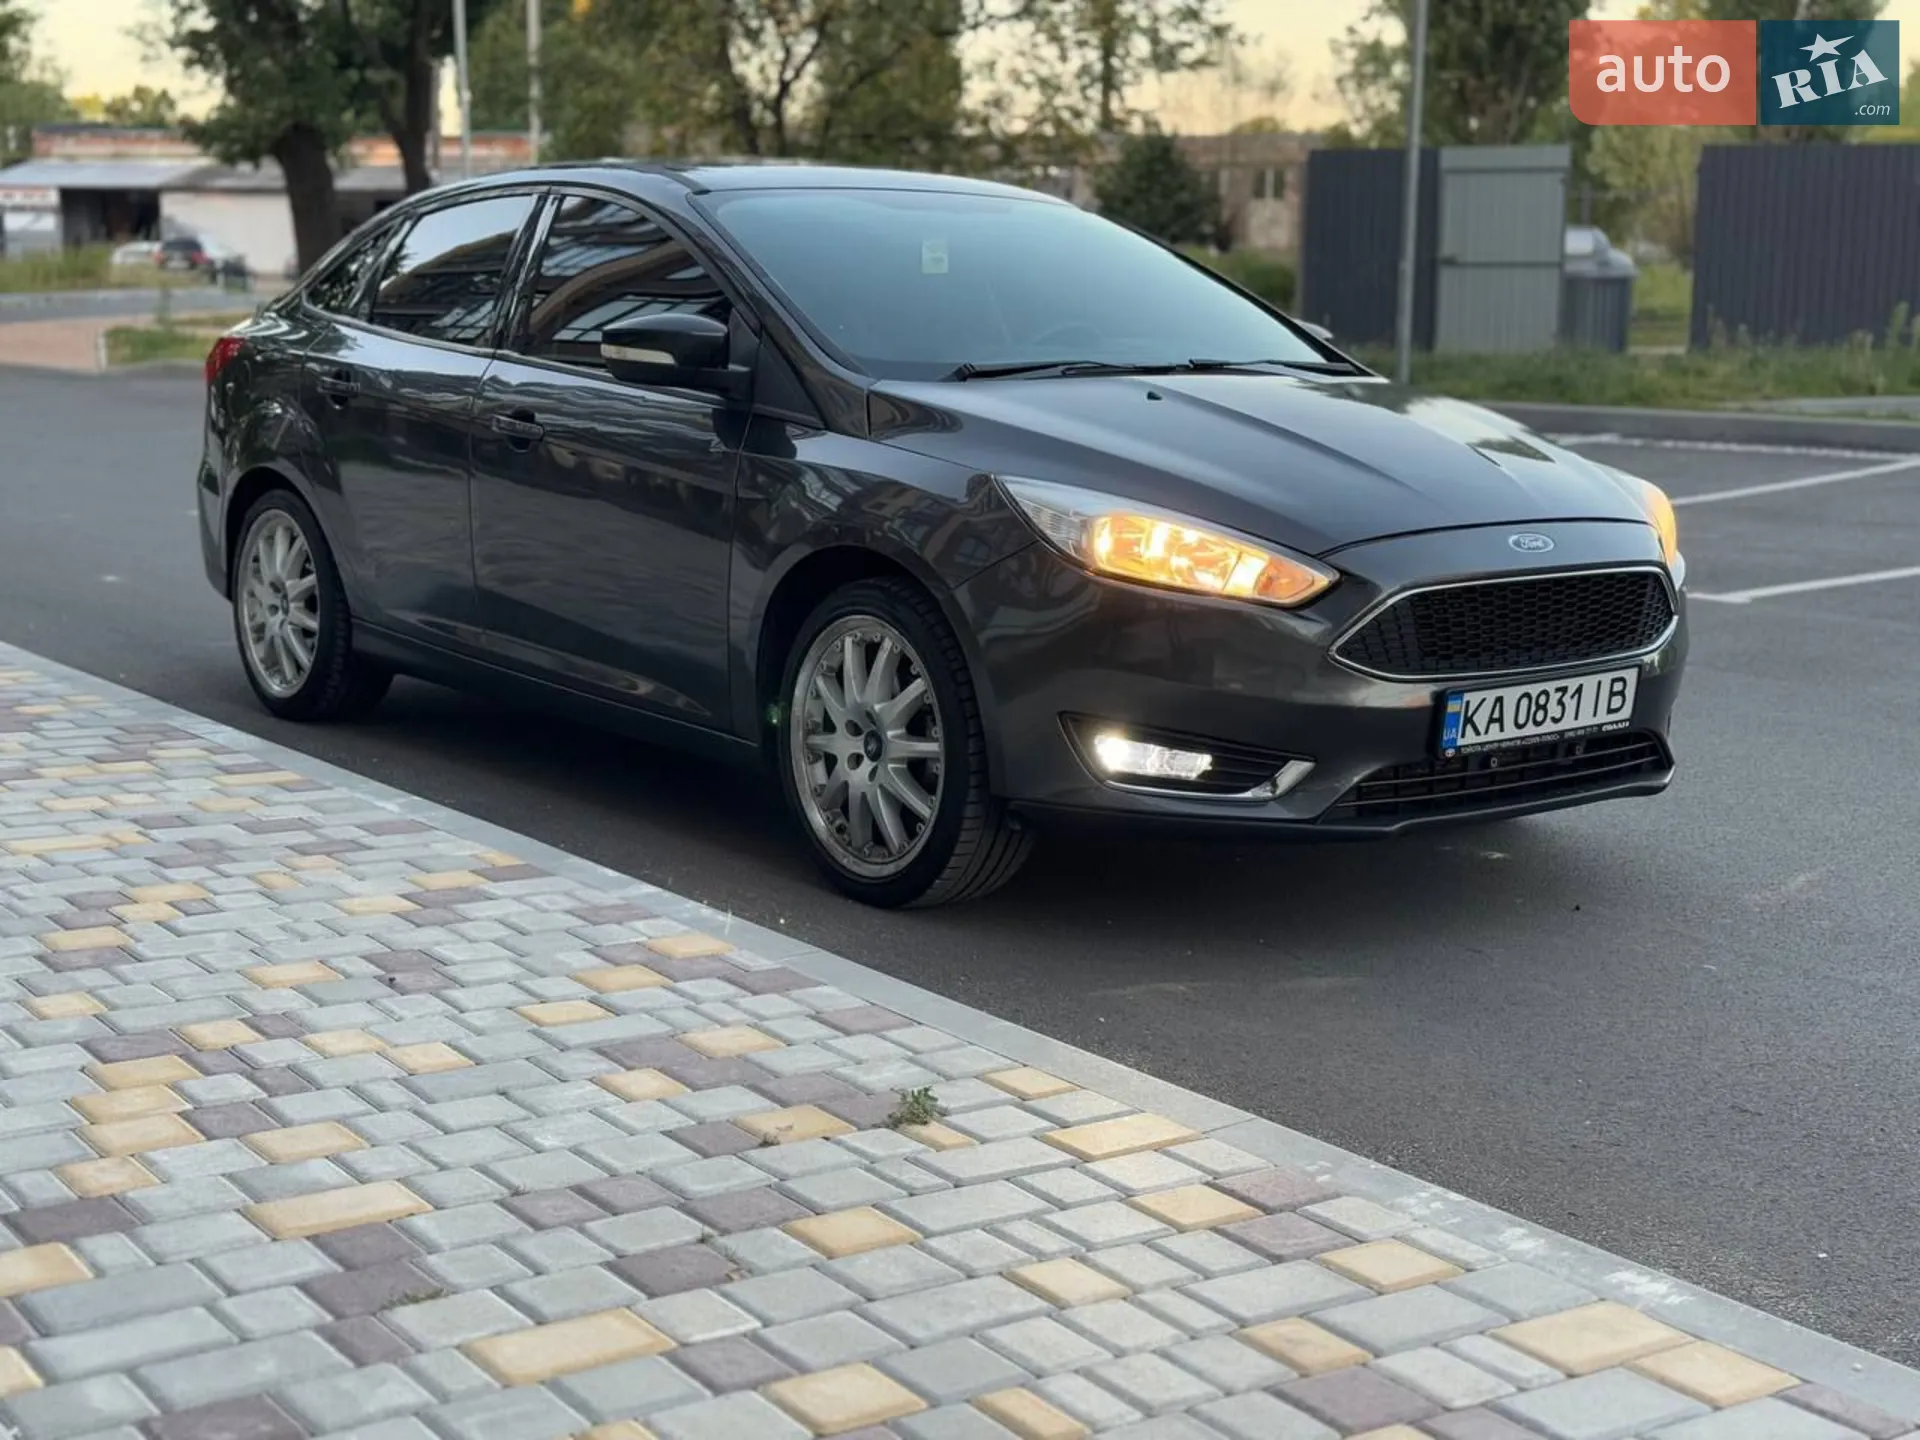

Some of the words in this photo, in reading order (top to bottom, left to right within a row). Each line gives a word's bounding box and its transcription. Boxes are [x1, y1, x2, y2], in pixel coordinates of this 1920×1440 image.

[1460, 695, 1504, 739] KA
[1513, 683, 1584, 730] 0831
[1592, 676, 1628, 718] IB
